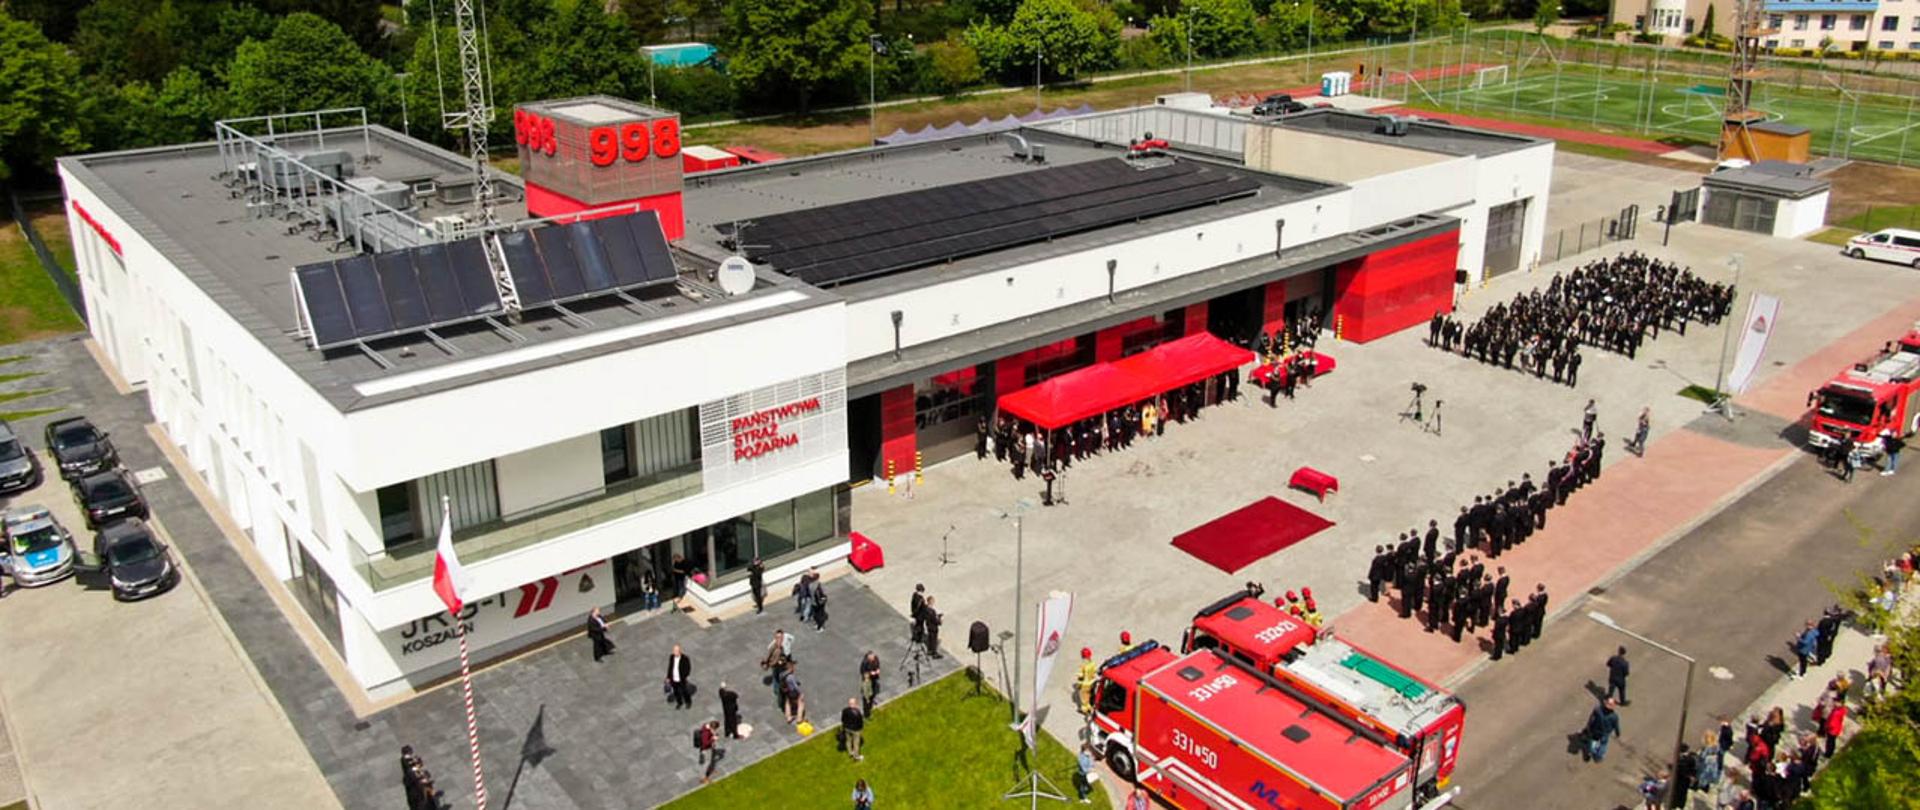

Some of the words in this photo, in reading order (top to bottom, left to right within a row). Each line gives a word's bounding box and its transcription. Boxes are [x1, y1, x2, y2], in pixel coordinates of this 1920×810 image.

[590, 118, 680, 167] 998
[734, 422, 778, 449] STRAŻ
[734, 433, 799, 464] POŻARNA
[402, 622, 474, 656] KOSZALN
